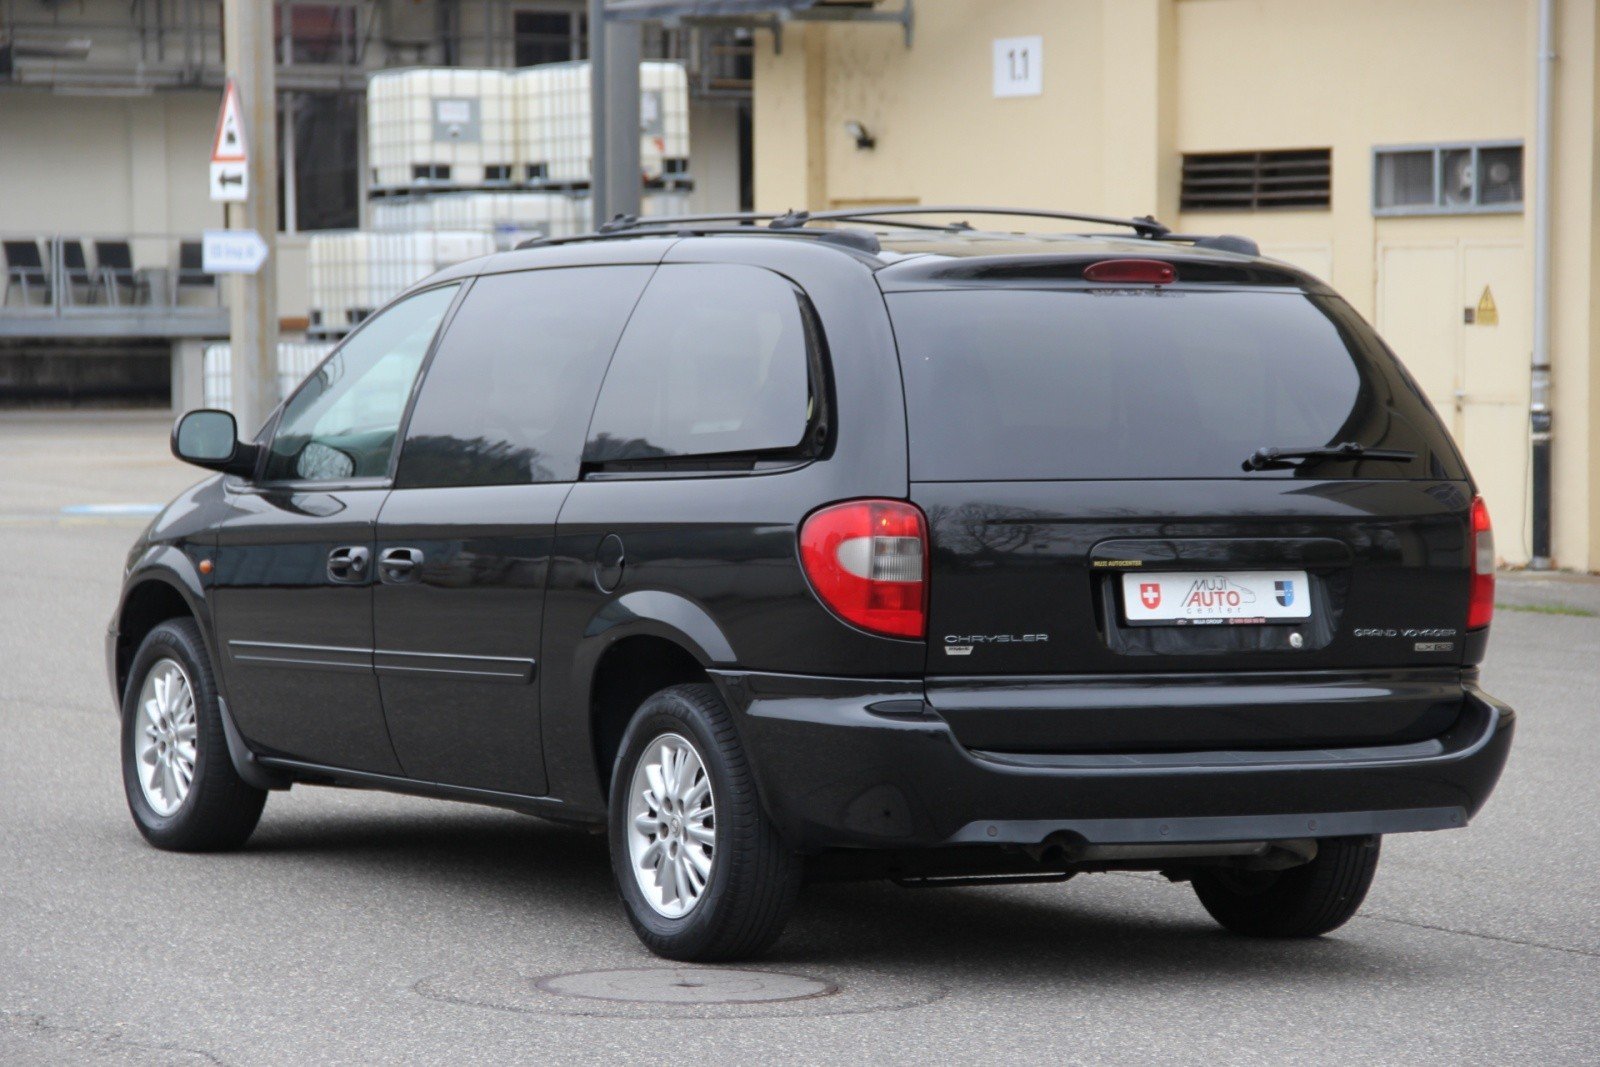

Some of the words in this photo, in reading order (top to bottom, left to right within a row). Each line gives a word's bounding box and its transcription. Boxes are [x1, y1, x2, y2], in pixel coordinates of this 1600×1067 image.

[1007, 49, 1029, 81] 1.1
[1187, 590, 1241, 607] AUTO
[1186, 606, 1242, 615] center
[1354, 628, 1397, 637] GRAND
[1401, 628, 1457, 637] VOYAGER
[944, 634, 1049, 643] CHRYSLER
